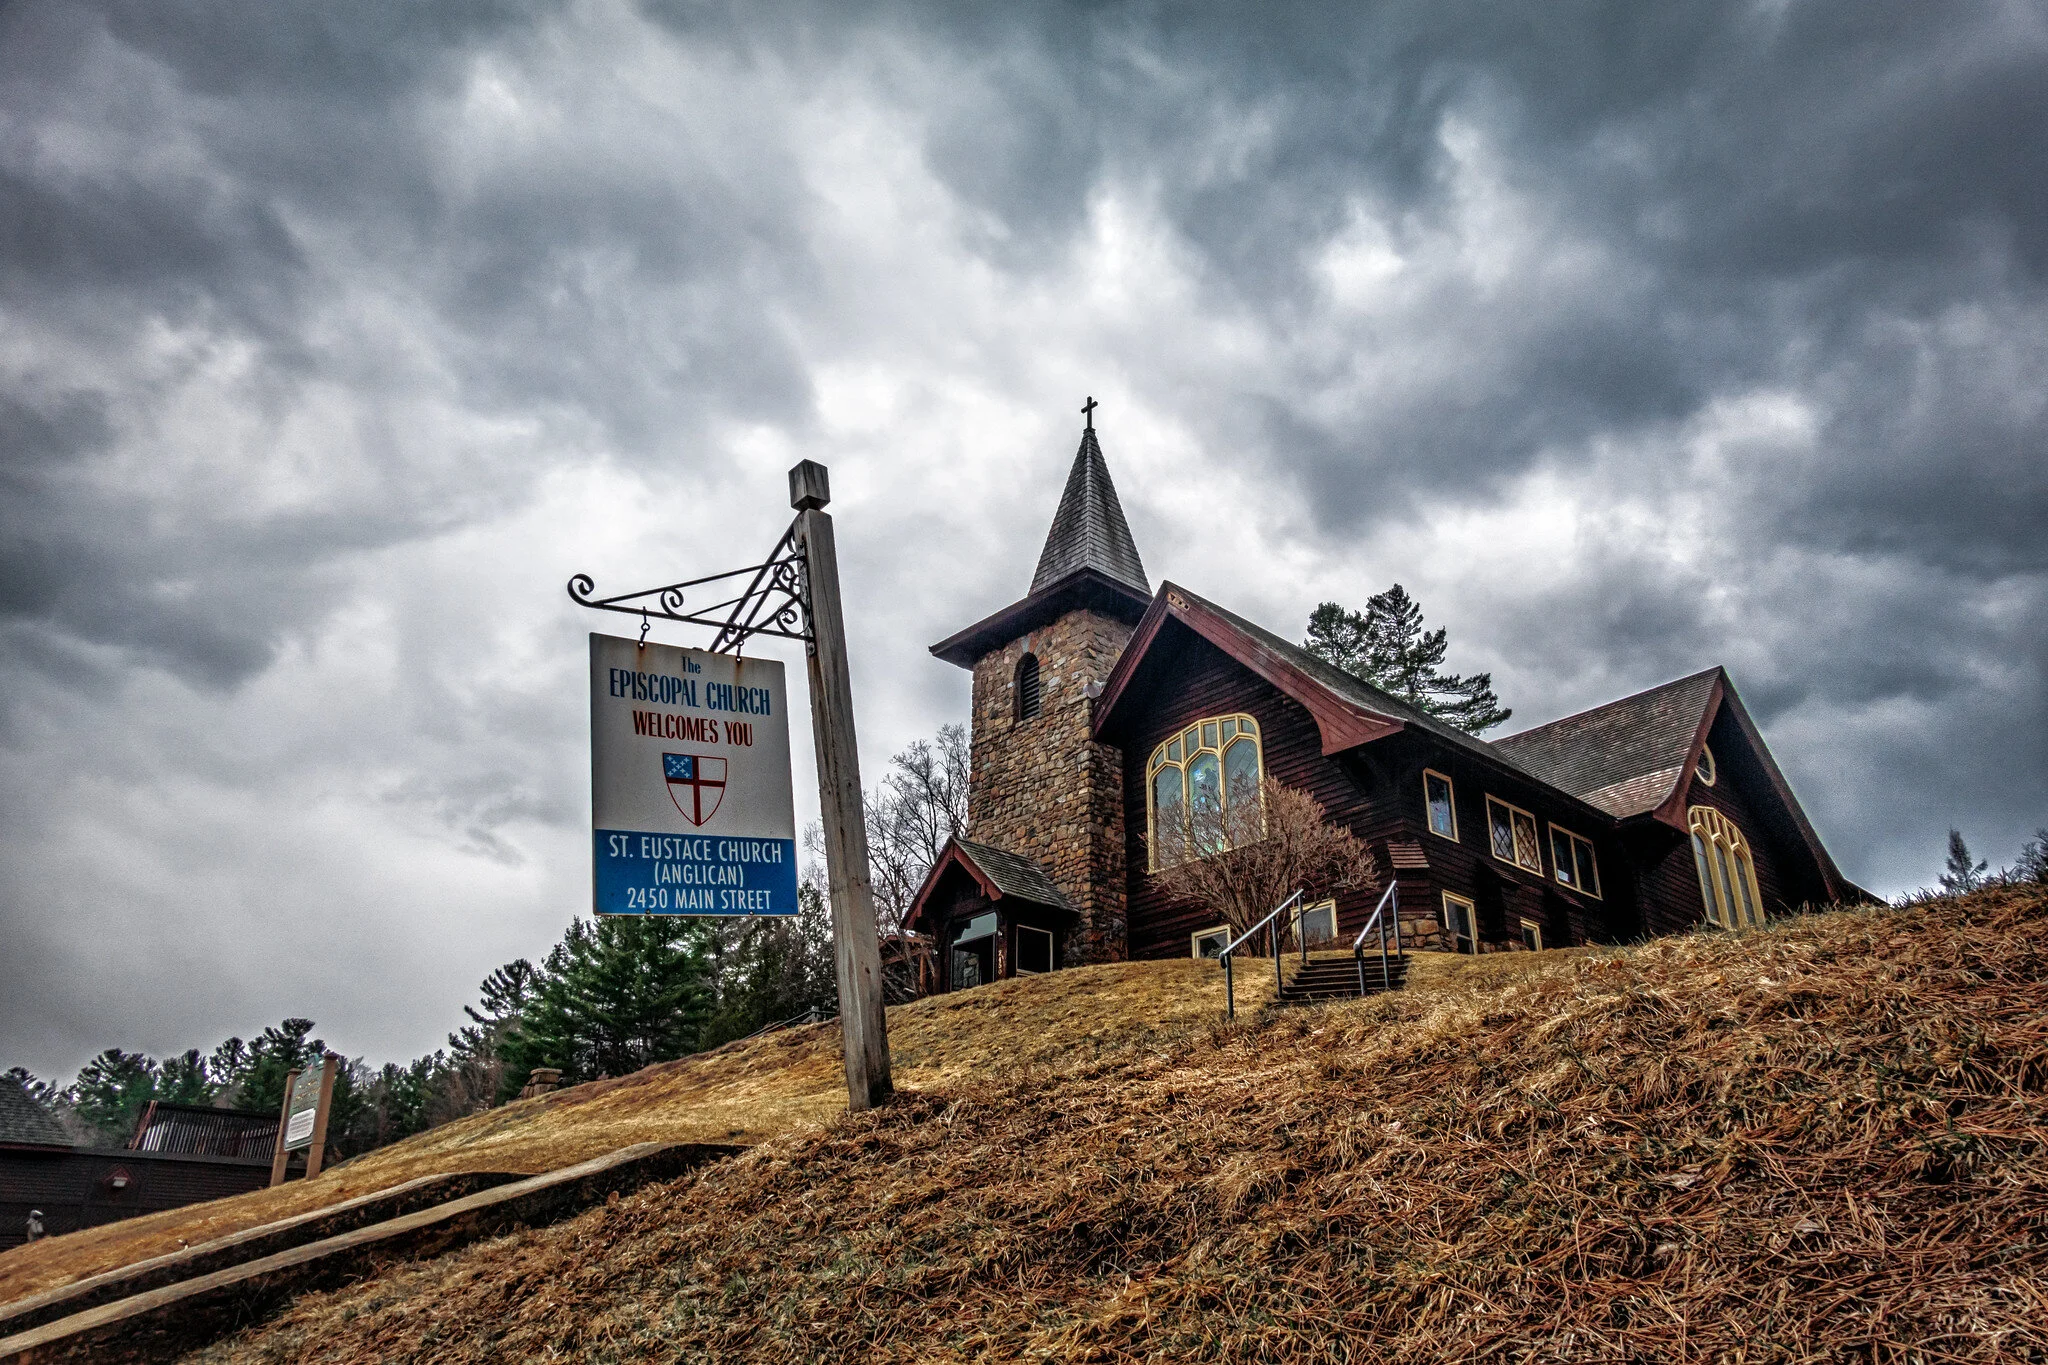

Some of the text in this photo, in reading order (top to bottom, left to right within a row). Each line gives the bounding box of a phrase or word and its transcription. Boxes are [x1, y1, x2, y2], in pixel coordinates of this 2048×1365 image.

[681, 656, 701, 675] The
[609, 668, 771, 716] EPISCOPAL CHURCH
[632, 710, 753, 747] WELCOMES YOU
[609, 835, 782, 864] ST. EUSTACE CHURCH
[654, 862, 745, 888] (ANGLICAN)
[627, 887, 772, 910] 2450 MAIN STREET
